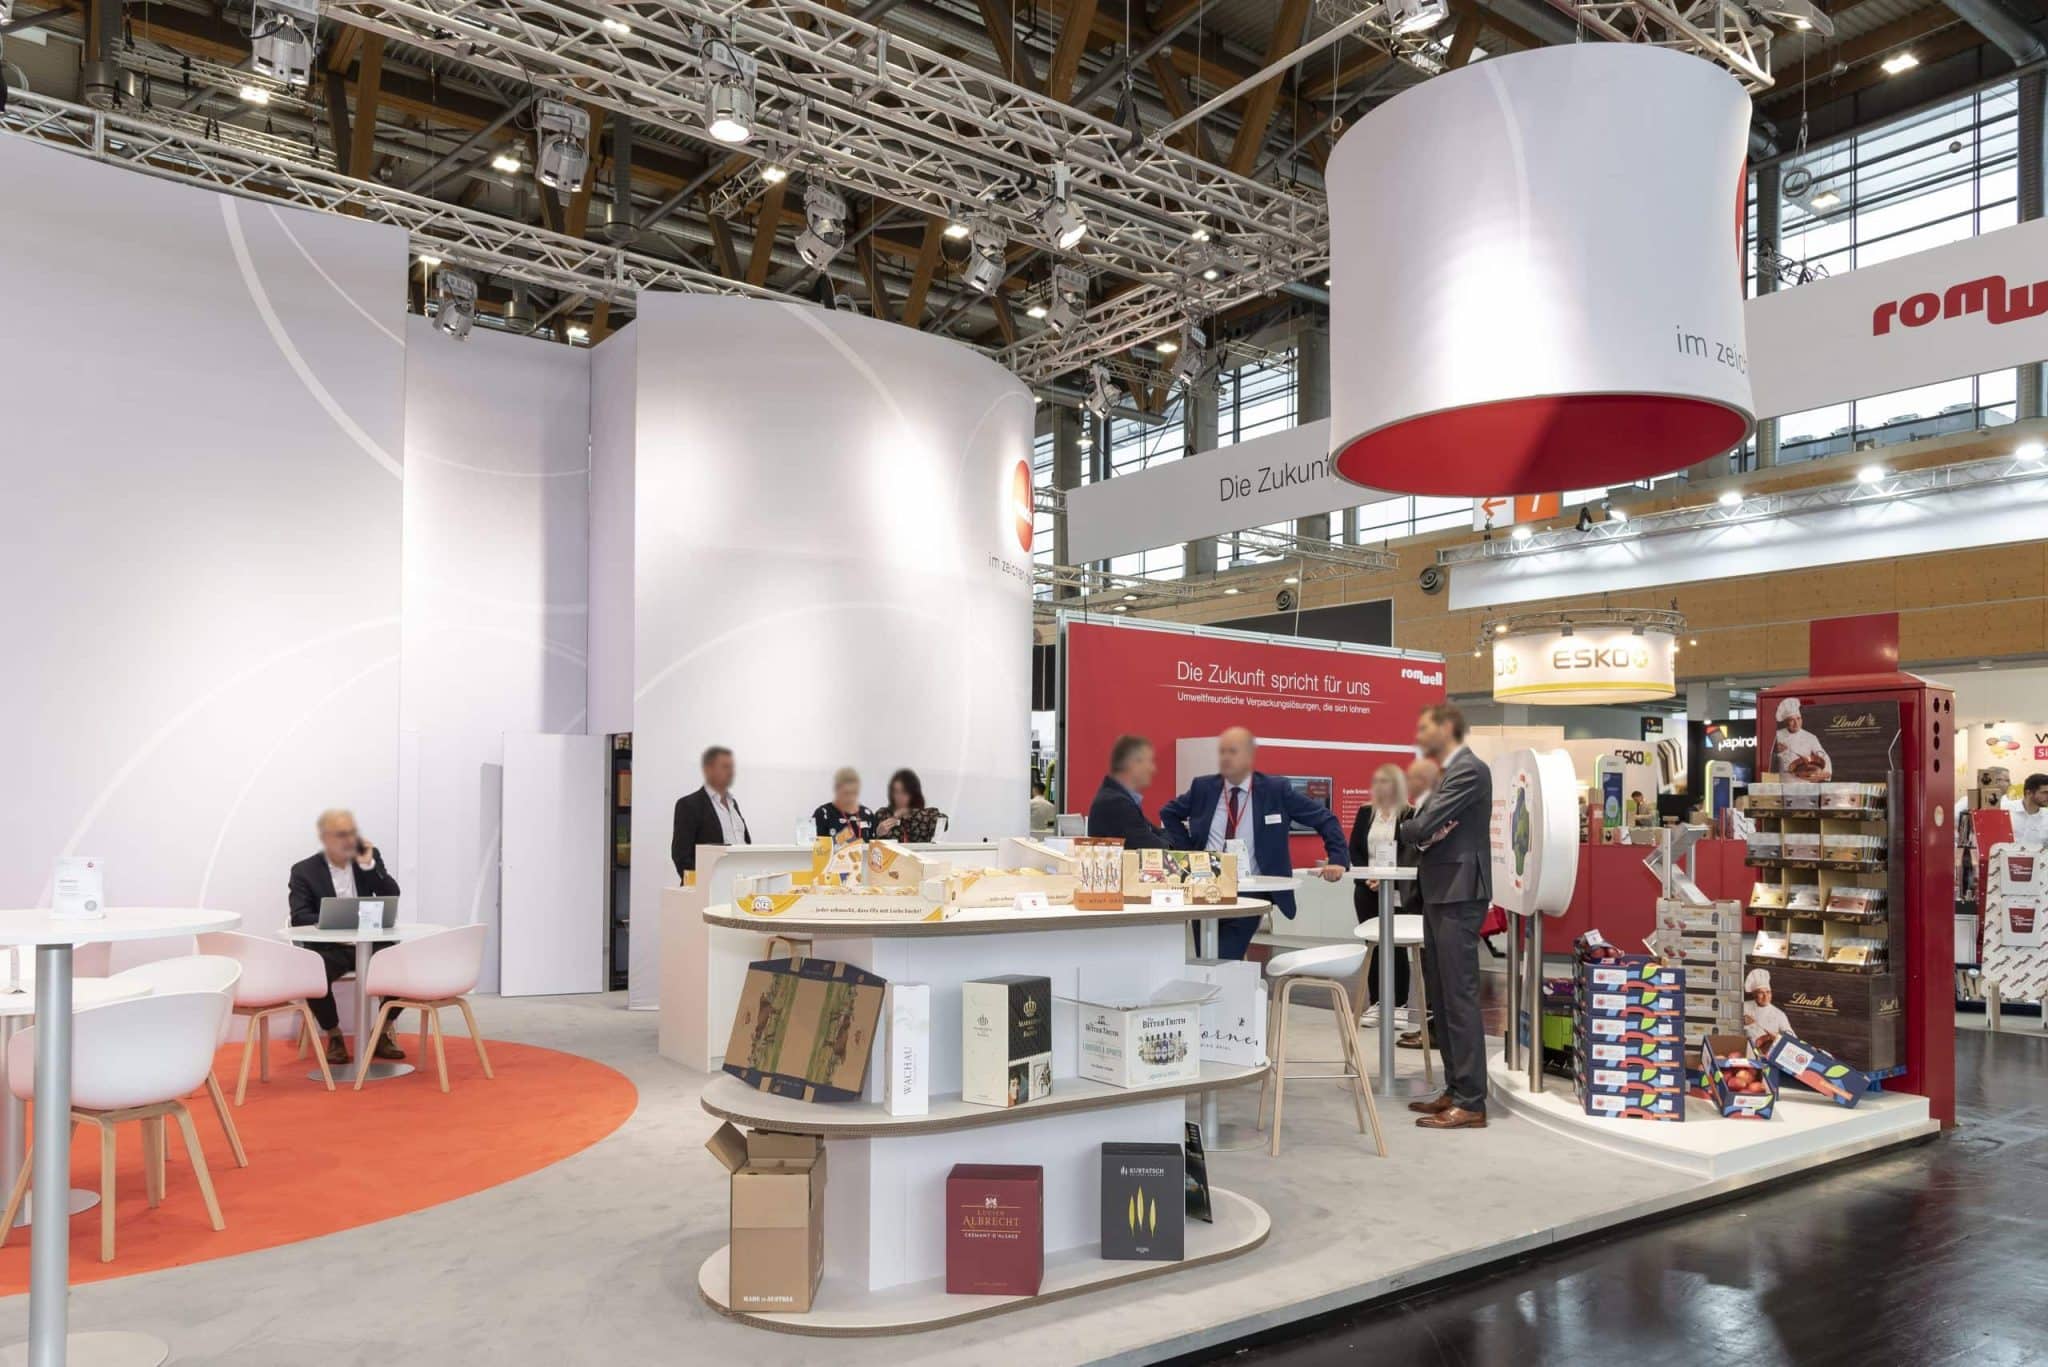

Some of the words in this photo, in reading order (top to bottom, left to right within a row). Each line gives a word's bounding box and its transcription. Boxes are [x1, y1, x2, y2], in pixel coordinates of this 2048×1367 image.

[1676, 324, 1708, 358] im
[1715, 342, 1746, 375] zeic
[1220, 474, 1251, 502] Die
[1258, 451, 1330, 493] Zukunf
[988, 551, 1000, 569] im
[1553, 648, 1629, 670] ESKO
[1177, 660, 1203, 682] Die
[1208, 663, 1265, 688] Zukunft
[1271, 671, 1319, 693] spricht
[1324, 674, 1341, 693] für
[1346, 682, 1370, 696] uns
[1177, 690, 1245, 705] Umweltfreundliche
[1246, 698, 1321, 713] Verpackungslösungen,
[1323, 702, 1333, 712] die
[1334, 703, 1348, 713] sich
[1349, 704, 1370, 715] lohnen
[1789, 992, 1825, 1007] Lindt
[903, 1046, 913, 1095] WACHAU
[963, 1215, 1020, 1229] ALBRECHT
